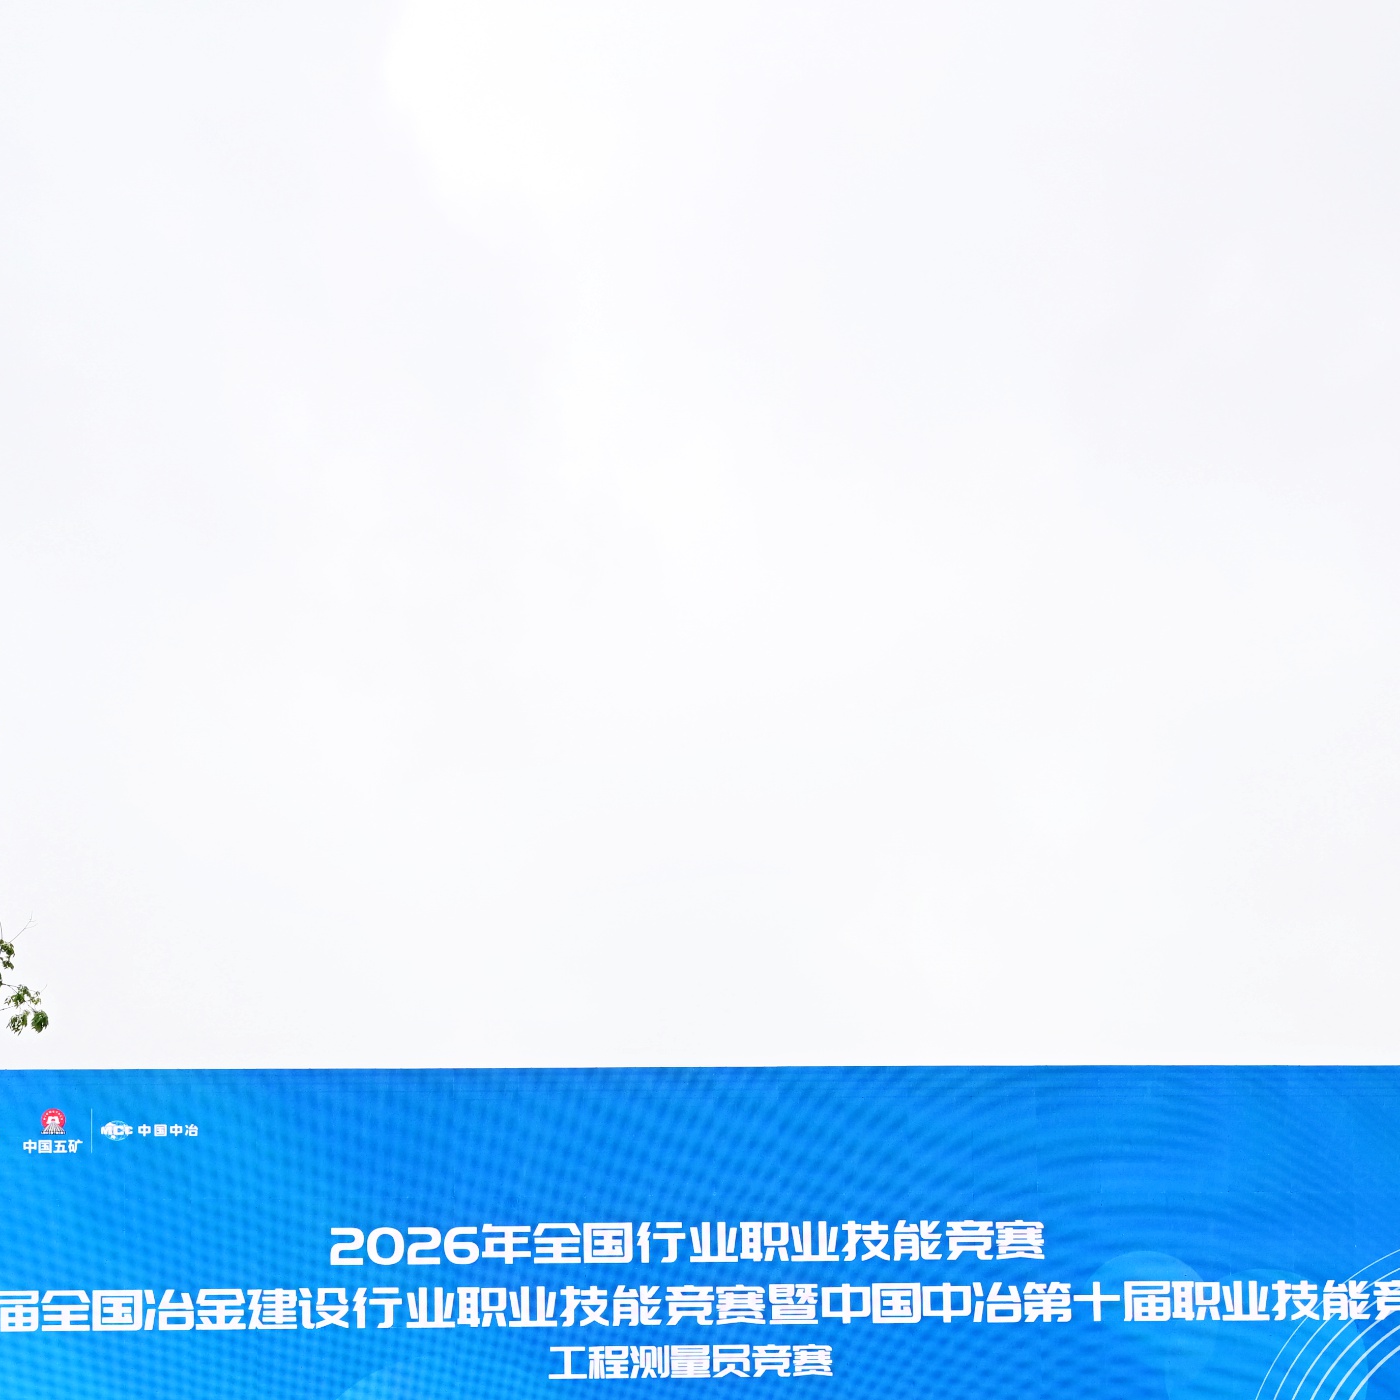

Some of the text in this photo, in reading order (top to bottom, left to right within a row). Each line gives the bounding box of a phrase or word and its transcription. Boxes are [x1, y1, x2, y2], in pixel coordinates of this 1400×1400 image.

[138, 1124, 198, 1136] 中国中冶
[23, 1139, 83, 1153] 中国五矿
[330, 1219, 1045, 1266] 2026年全国行业职业技能竞赛
[548, 1344, 833, 1380] 工程测量员竞赛
